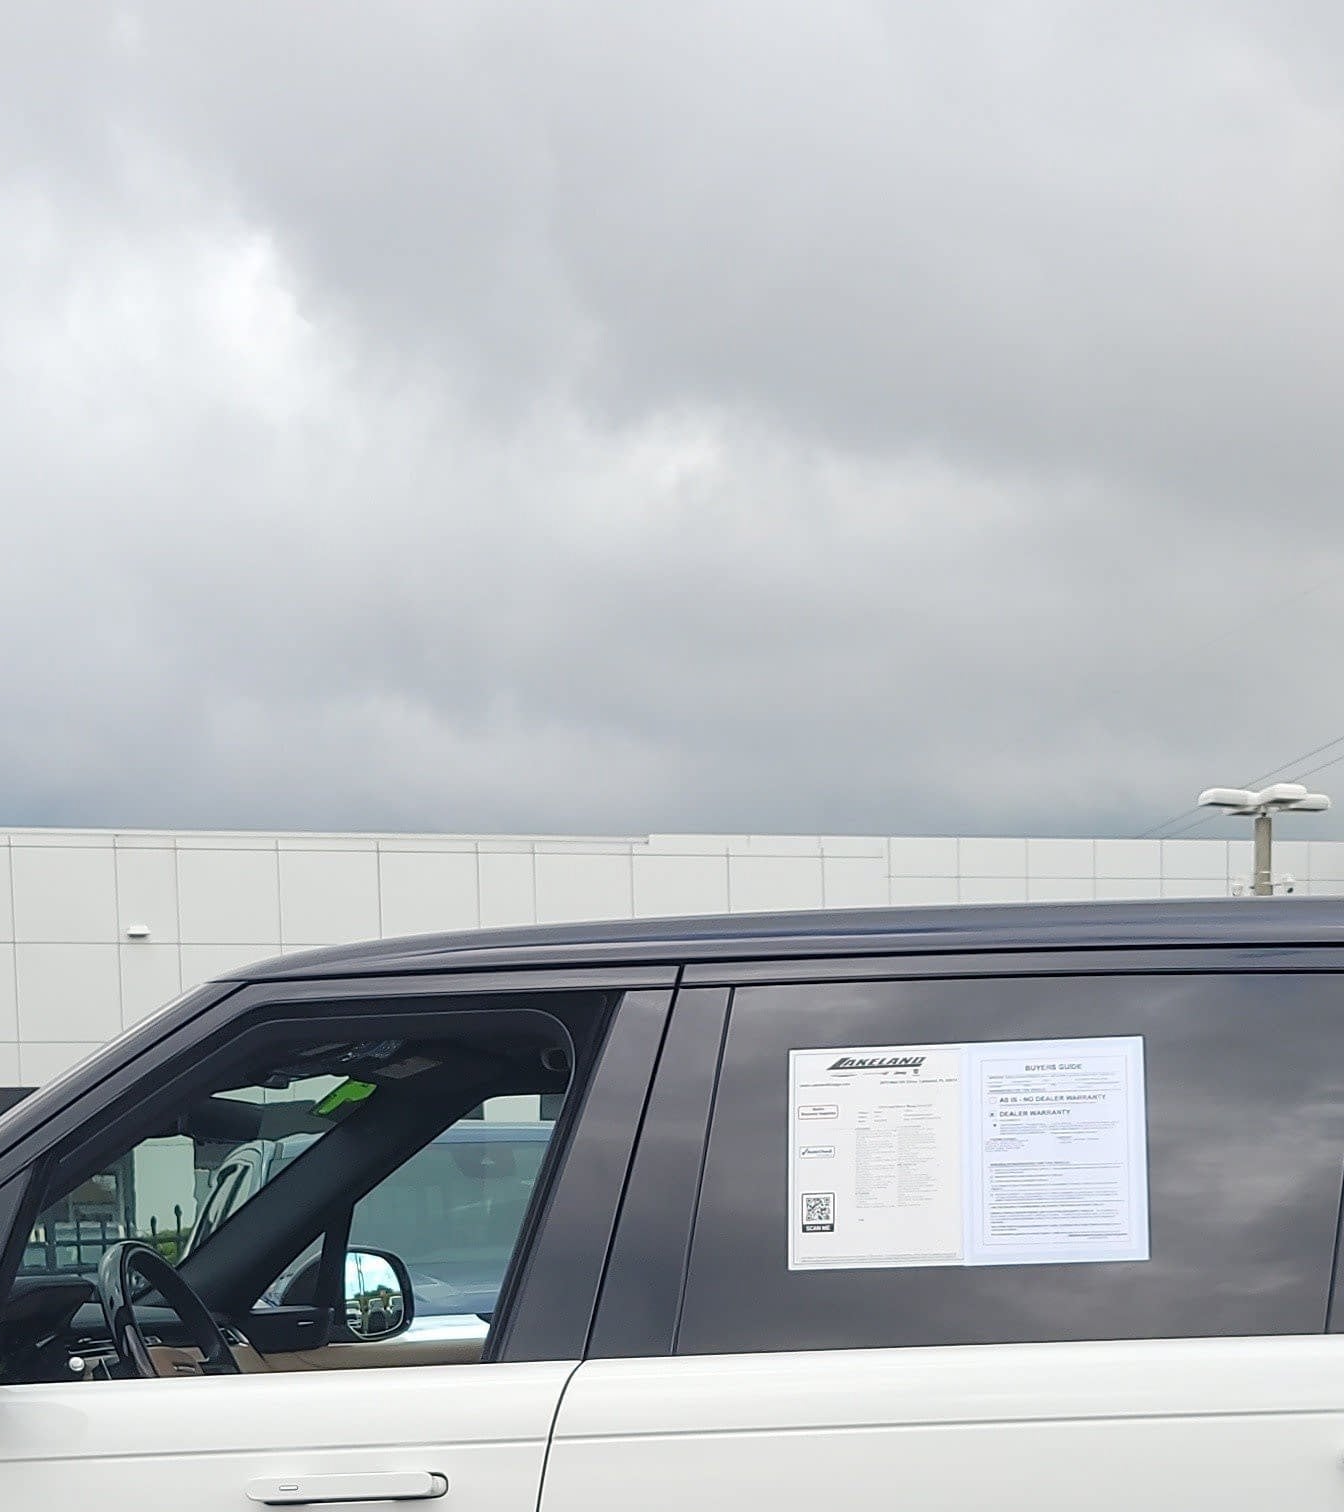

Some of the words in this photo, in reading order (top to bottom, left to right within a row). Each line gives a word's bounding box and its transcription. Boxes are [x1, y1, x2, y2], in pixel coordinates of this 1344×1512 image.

[827, 1056, 927, 1070] LAKELAND
[1024, 1063, 1057, 1071] BUYERS
[1058, 1062, 1082, 1070] GUIDE
[999, 1110, 1028, 1118] DEALER
[1029, 1109, 1071, 1117] WARRANTY
[805, 1224, 822, 1232] SCAN
